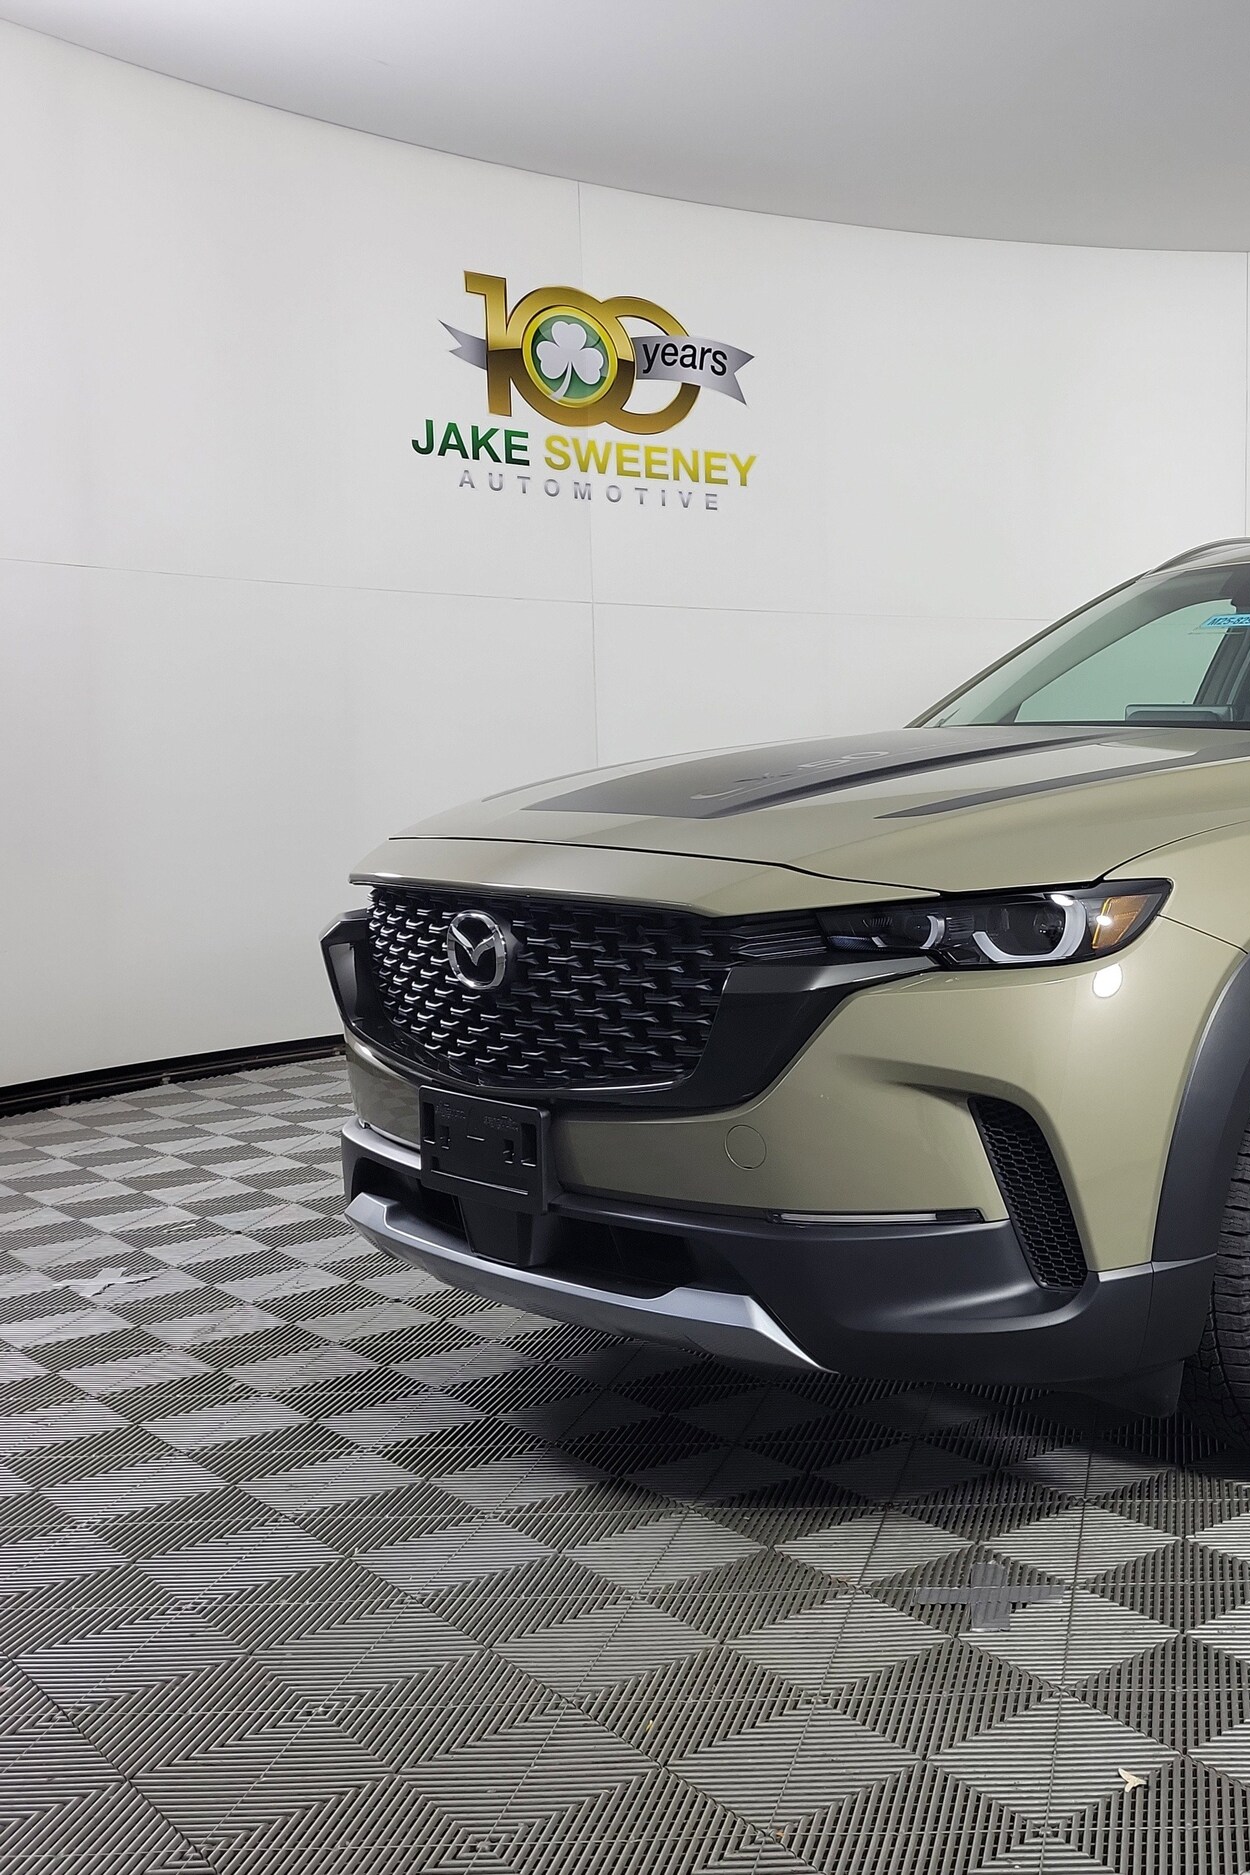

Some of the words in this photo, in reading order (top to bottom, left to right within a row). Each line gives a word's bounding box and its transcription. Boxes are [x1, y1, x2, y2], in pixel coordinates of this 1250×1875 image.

[464, 270, 700, 435] 100
[641, 342, 728, 376] years
[411, 418, 530, 466] JAKE
[544, 434, 757, 486] SWEENEY
[459, 469, 719, 511] AUTOMOTIVE
